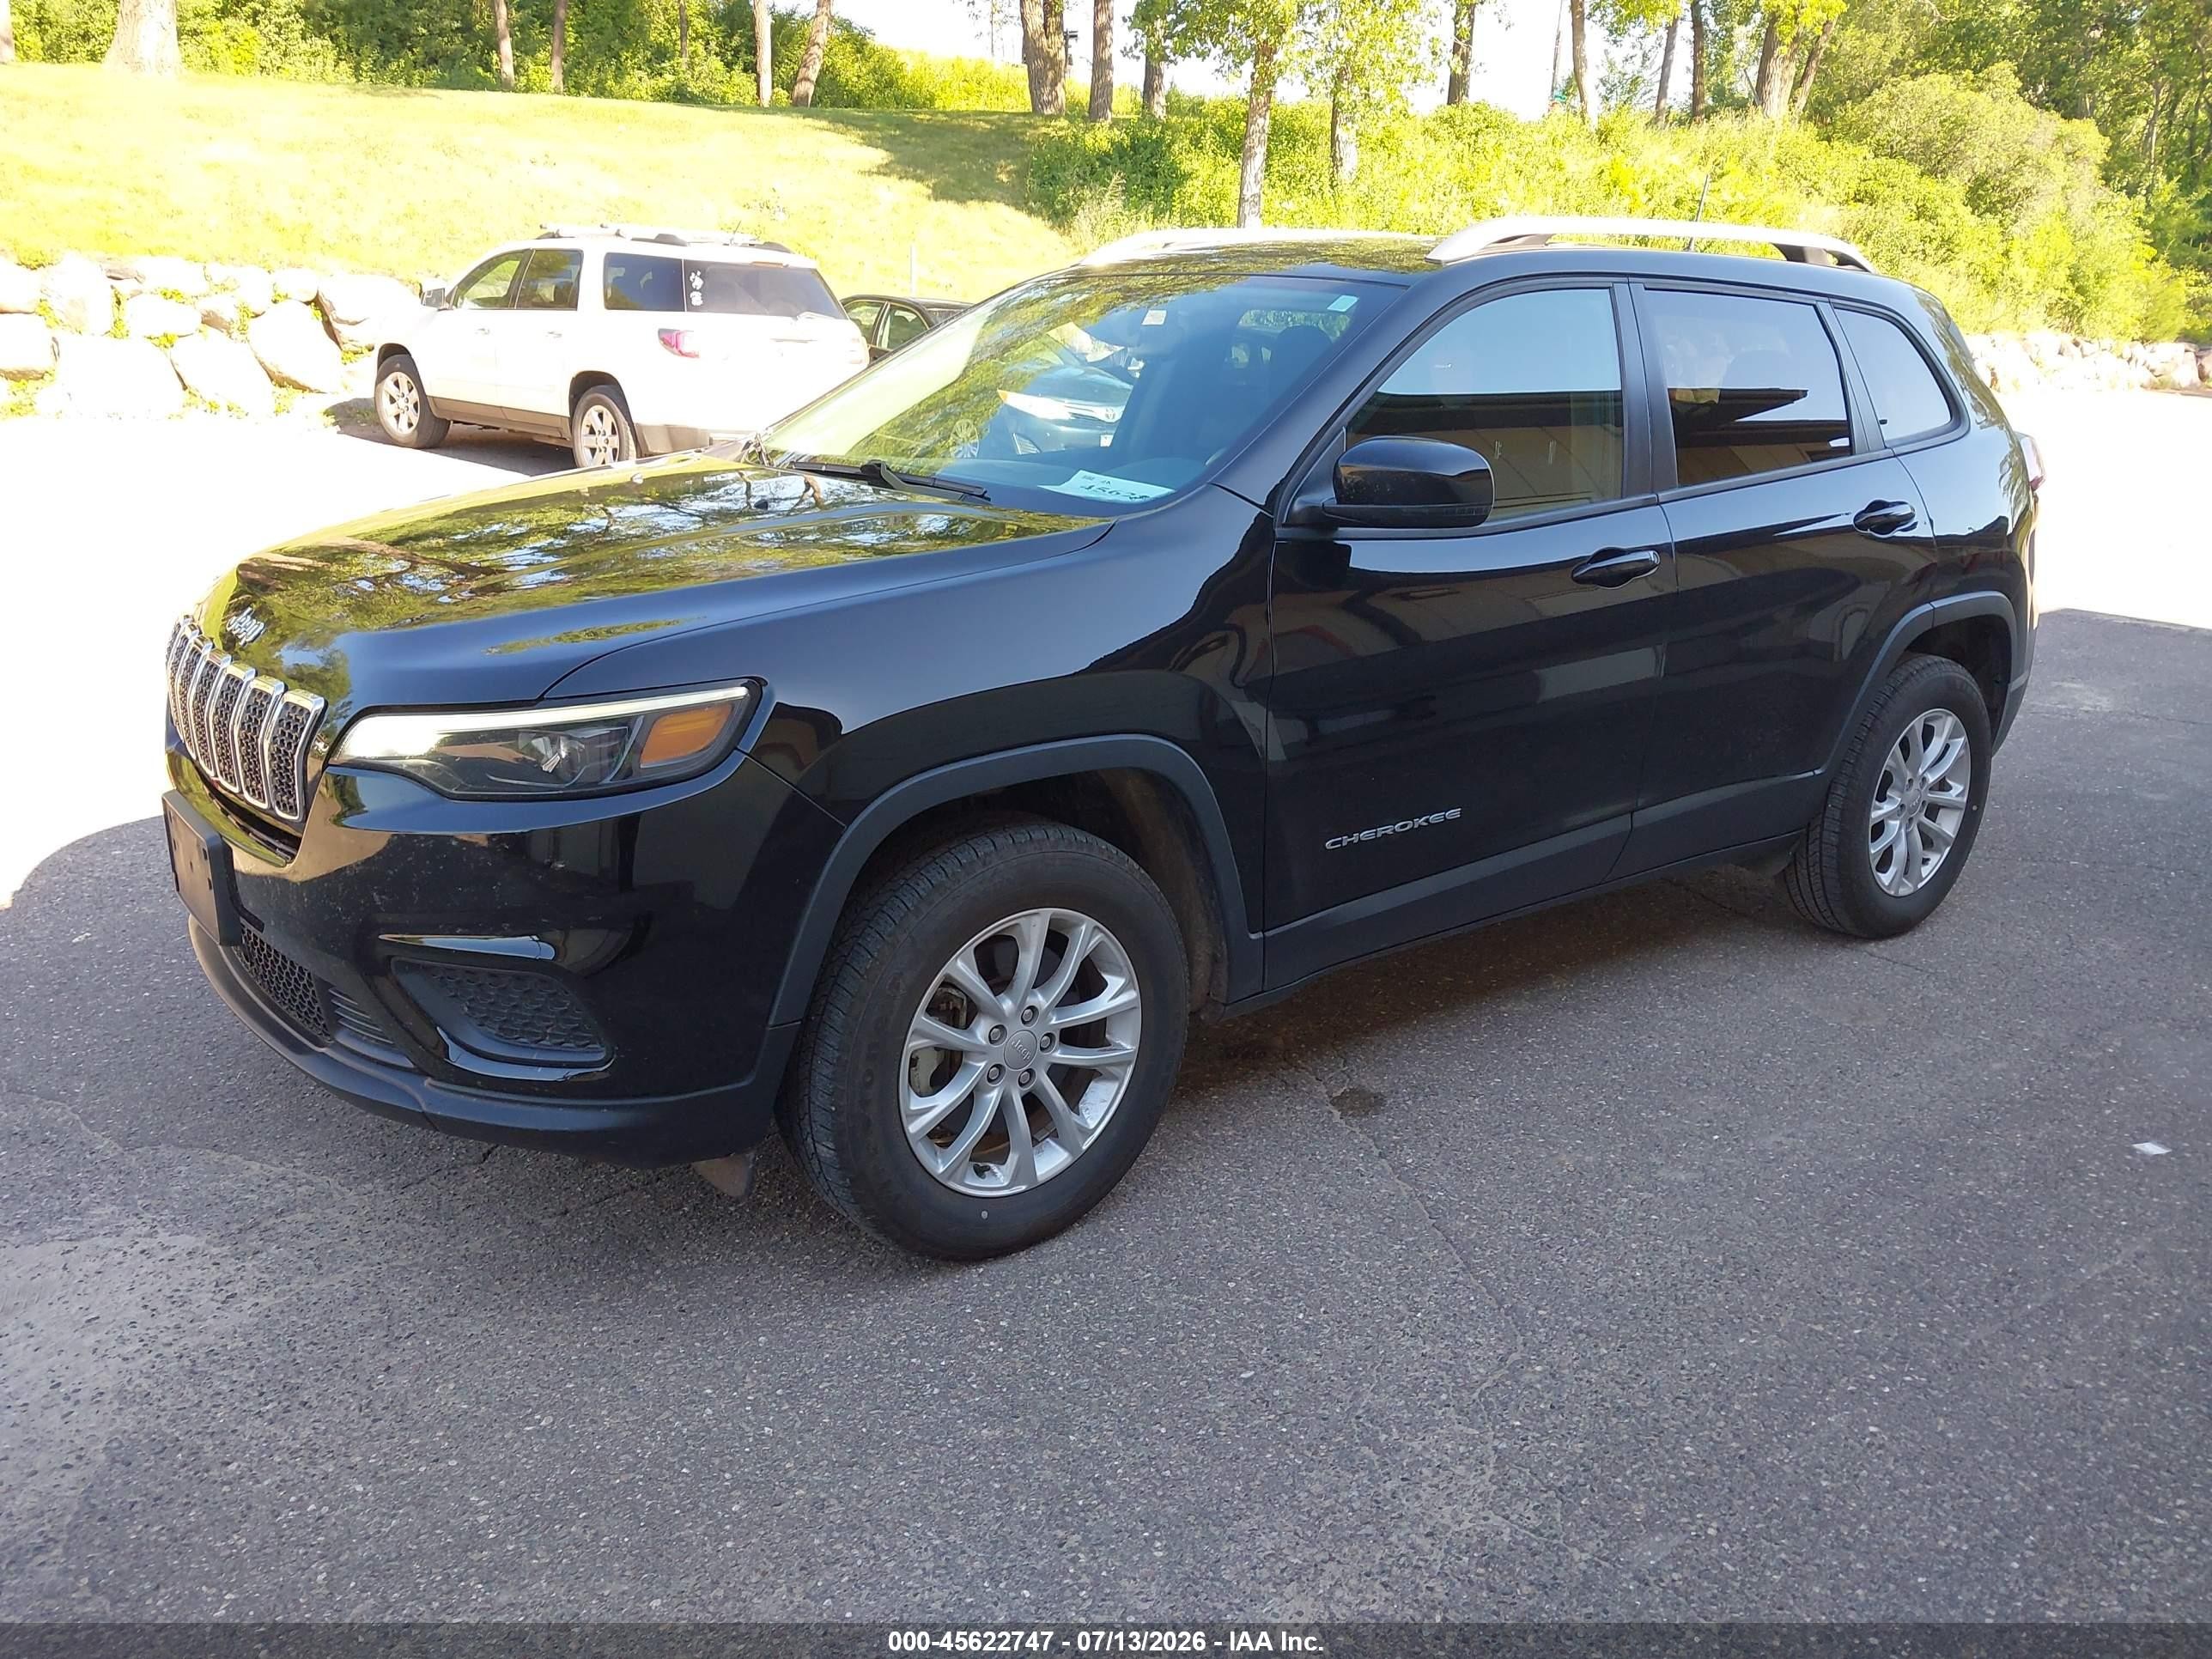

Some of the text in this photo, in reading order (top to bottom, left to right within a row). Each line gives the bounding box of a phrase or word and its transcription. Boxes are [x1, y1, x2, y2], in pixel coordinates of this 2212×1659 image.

[226, 606, 265, 647] Jeep
[1325, 807, 1462, 850] CHEROKEE
[1011, 1039, 1031, 1060] Jeep
